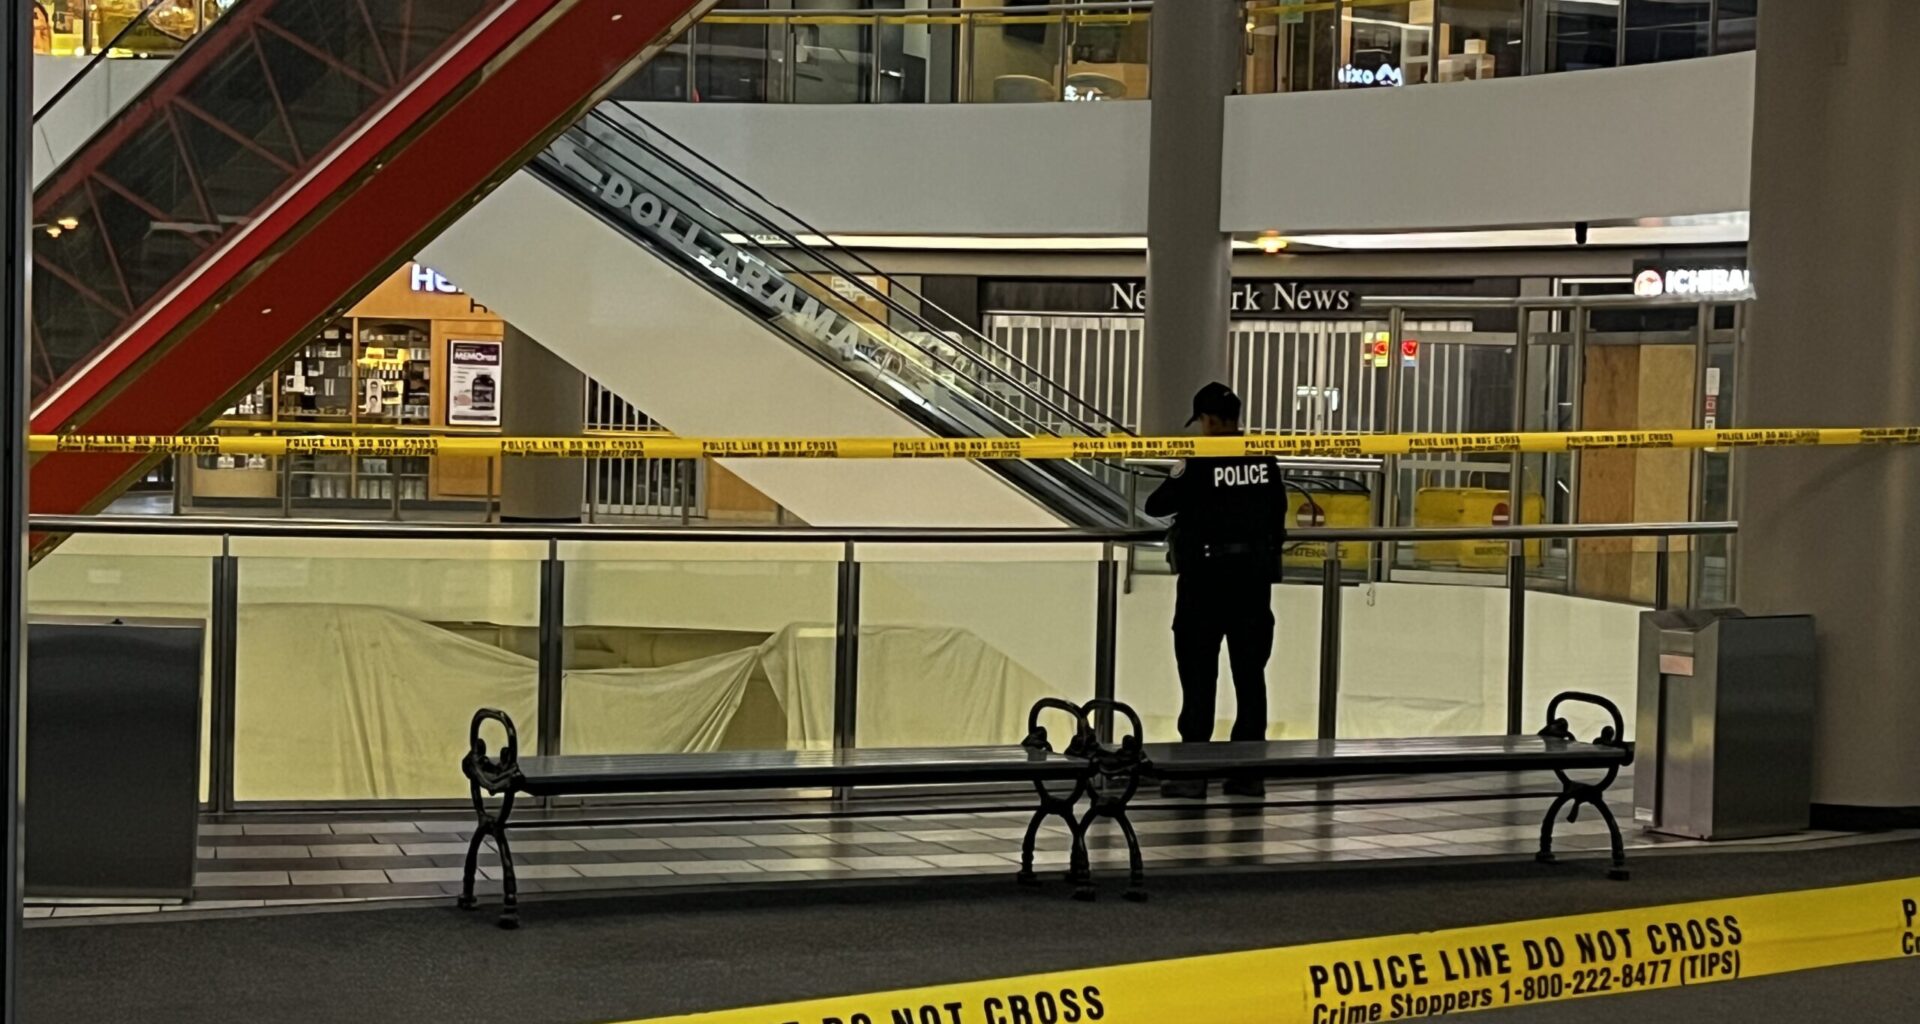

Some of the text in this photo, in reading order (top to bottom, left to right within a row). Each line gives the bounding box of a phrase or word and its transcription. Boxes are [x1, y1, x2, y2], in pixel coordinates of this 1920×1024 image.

[601, 172, 859, 361] DOLLARAMA
[1111, 282, 1350, 311] Ne rk News
[1214, 463, 1269, 487] POLICE
[1309, 915, 1742, 998] POLICE LINE DO NOT CROSS
[983, 985, 1105, 1024] CROSS
[1312, 949, 1741, 1024] Crime Stoppers 1-800-222-8477 (TIPS)
